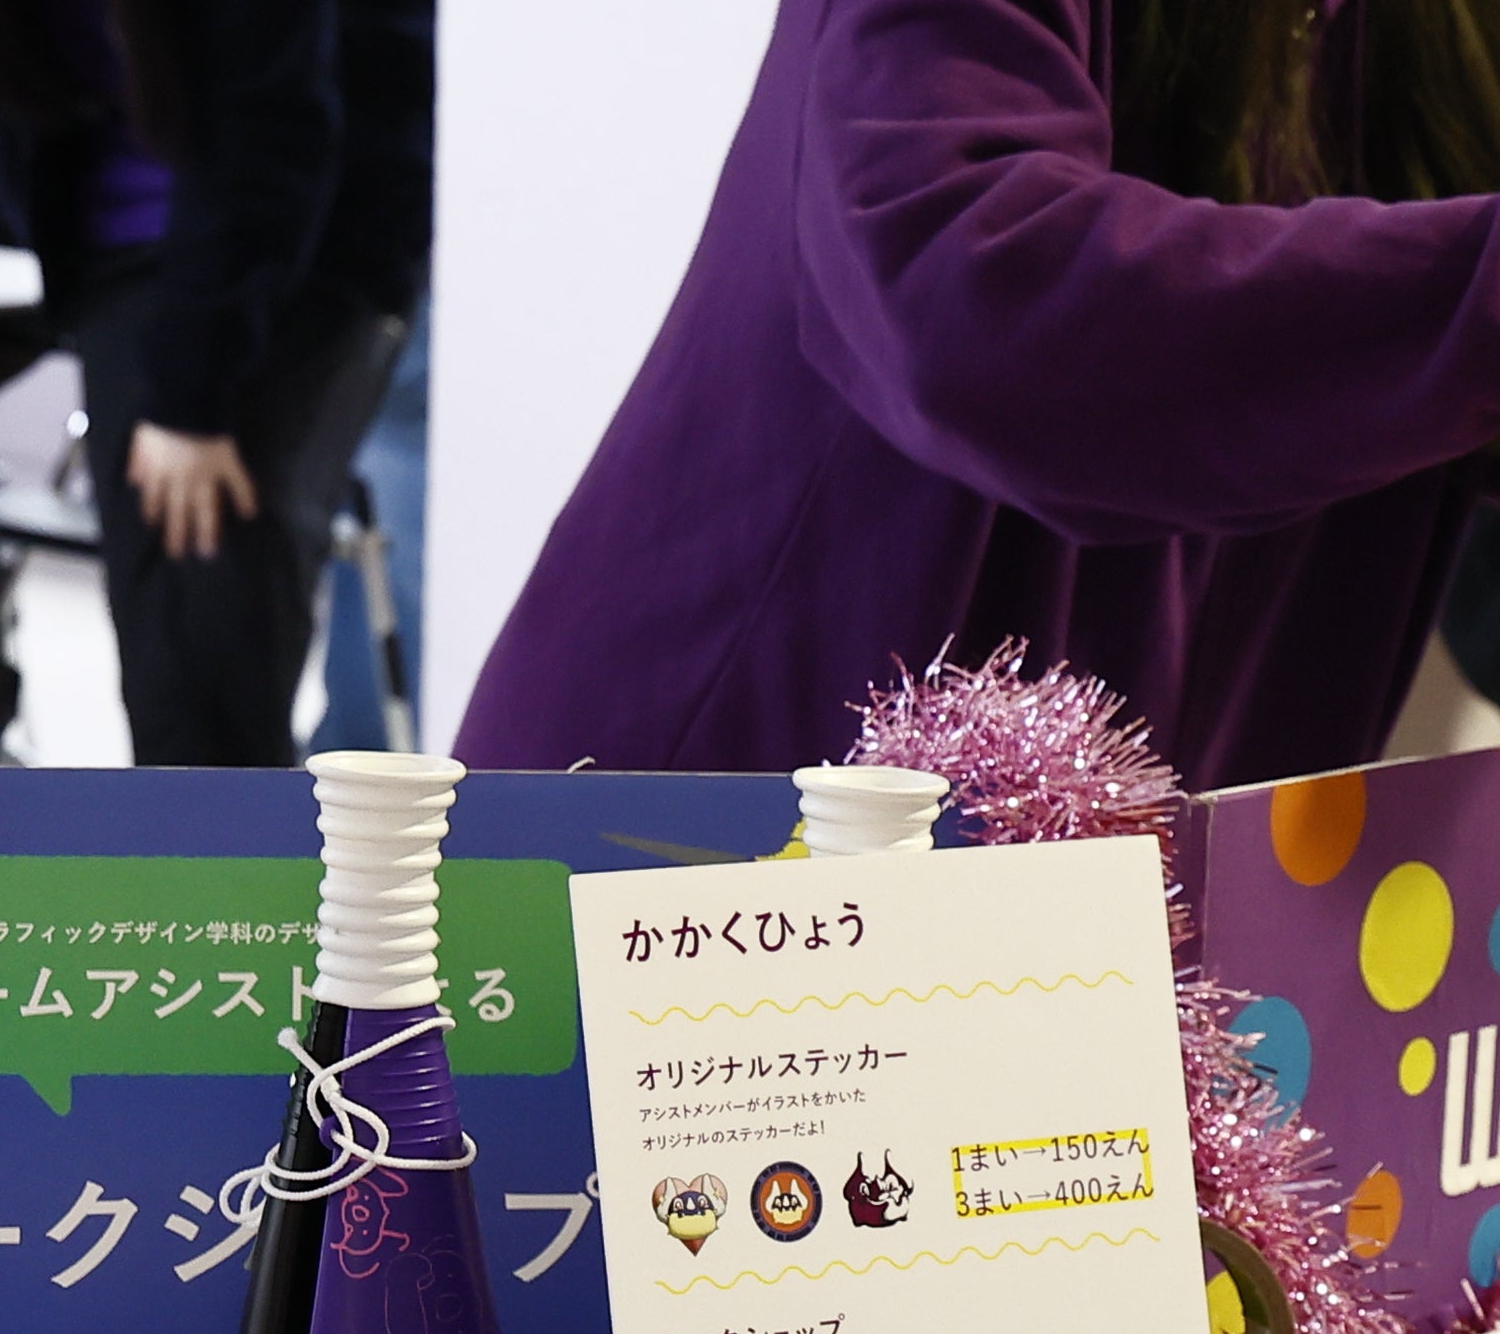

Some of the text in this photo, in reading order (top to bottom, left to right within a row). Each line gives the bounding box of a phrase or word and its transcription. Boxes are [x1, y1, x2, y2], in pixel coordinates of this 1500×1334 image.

[621, 902, 866, 963] かかくひょう
[636, 1043, 908, 1092] オリジナルステッカー
[639, 1087, 867, 1123] アシストメンバーがイラストをかいた
